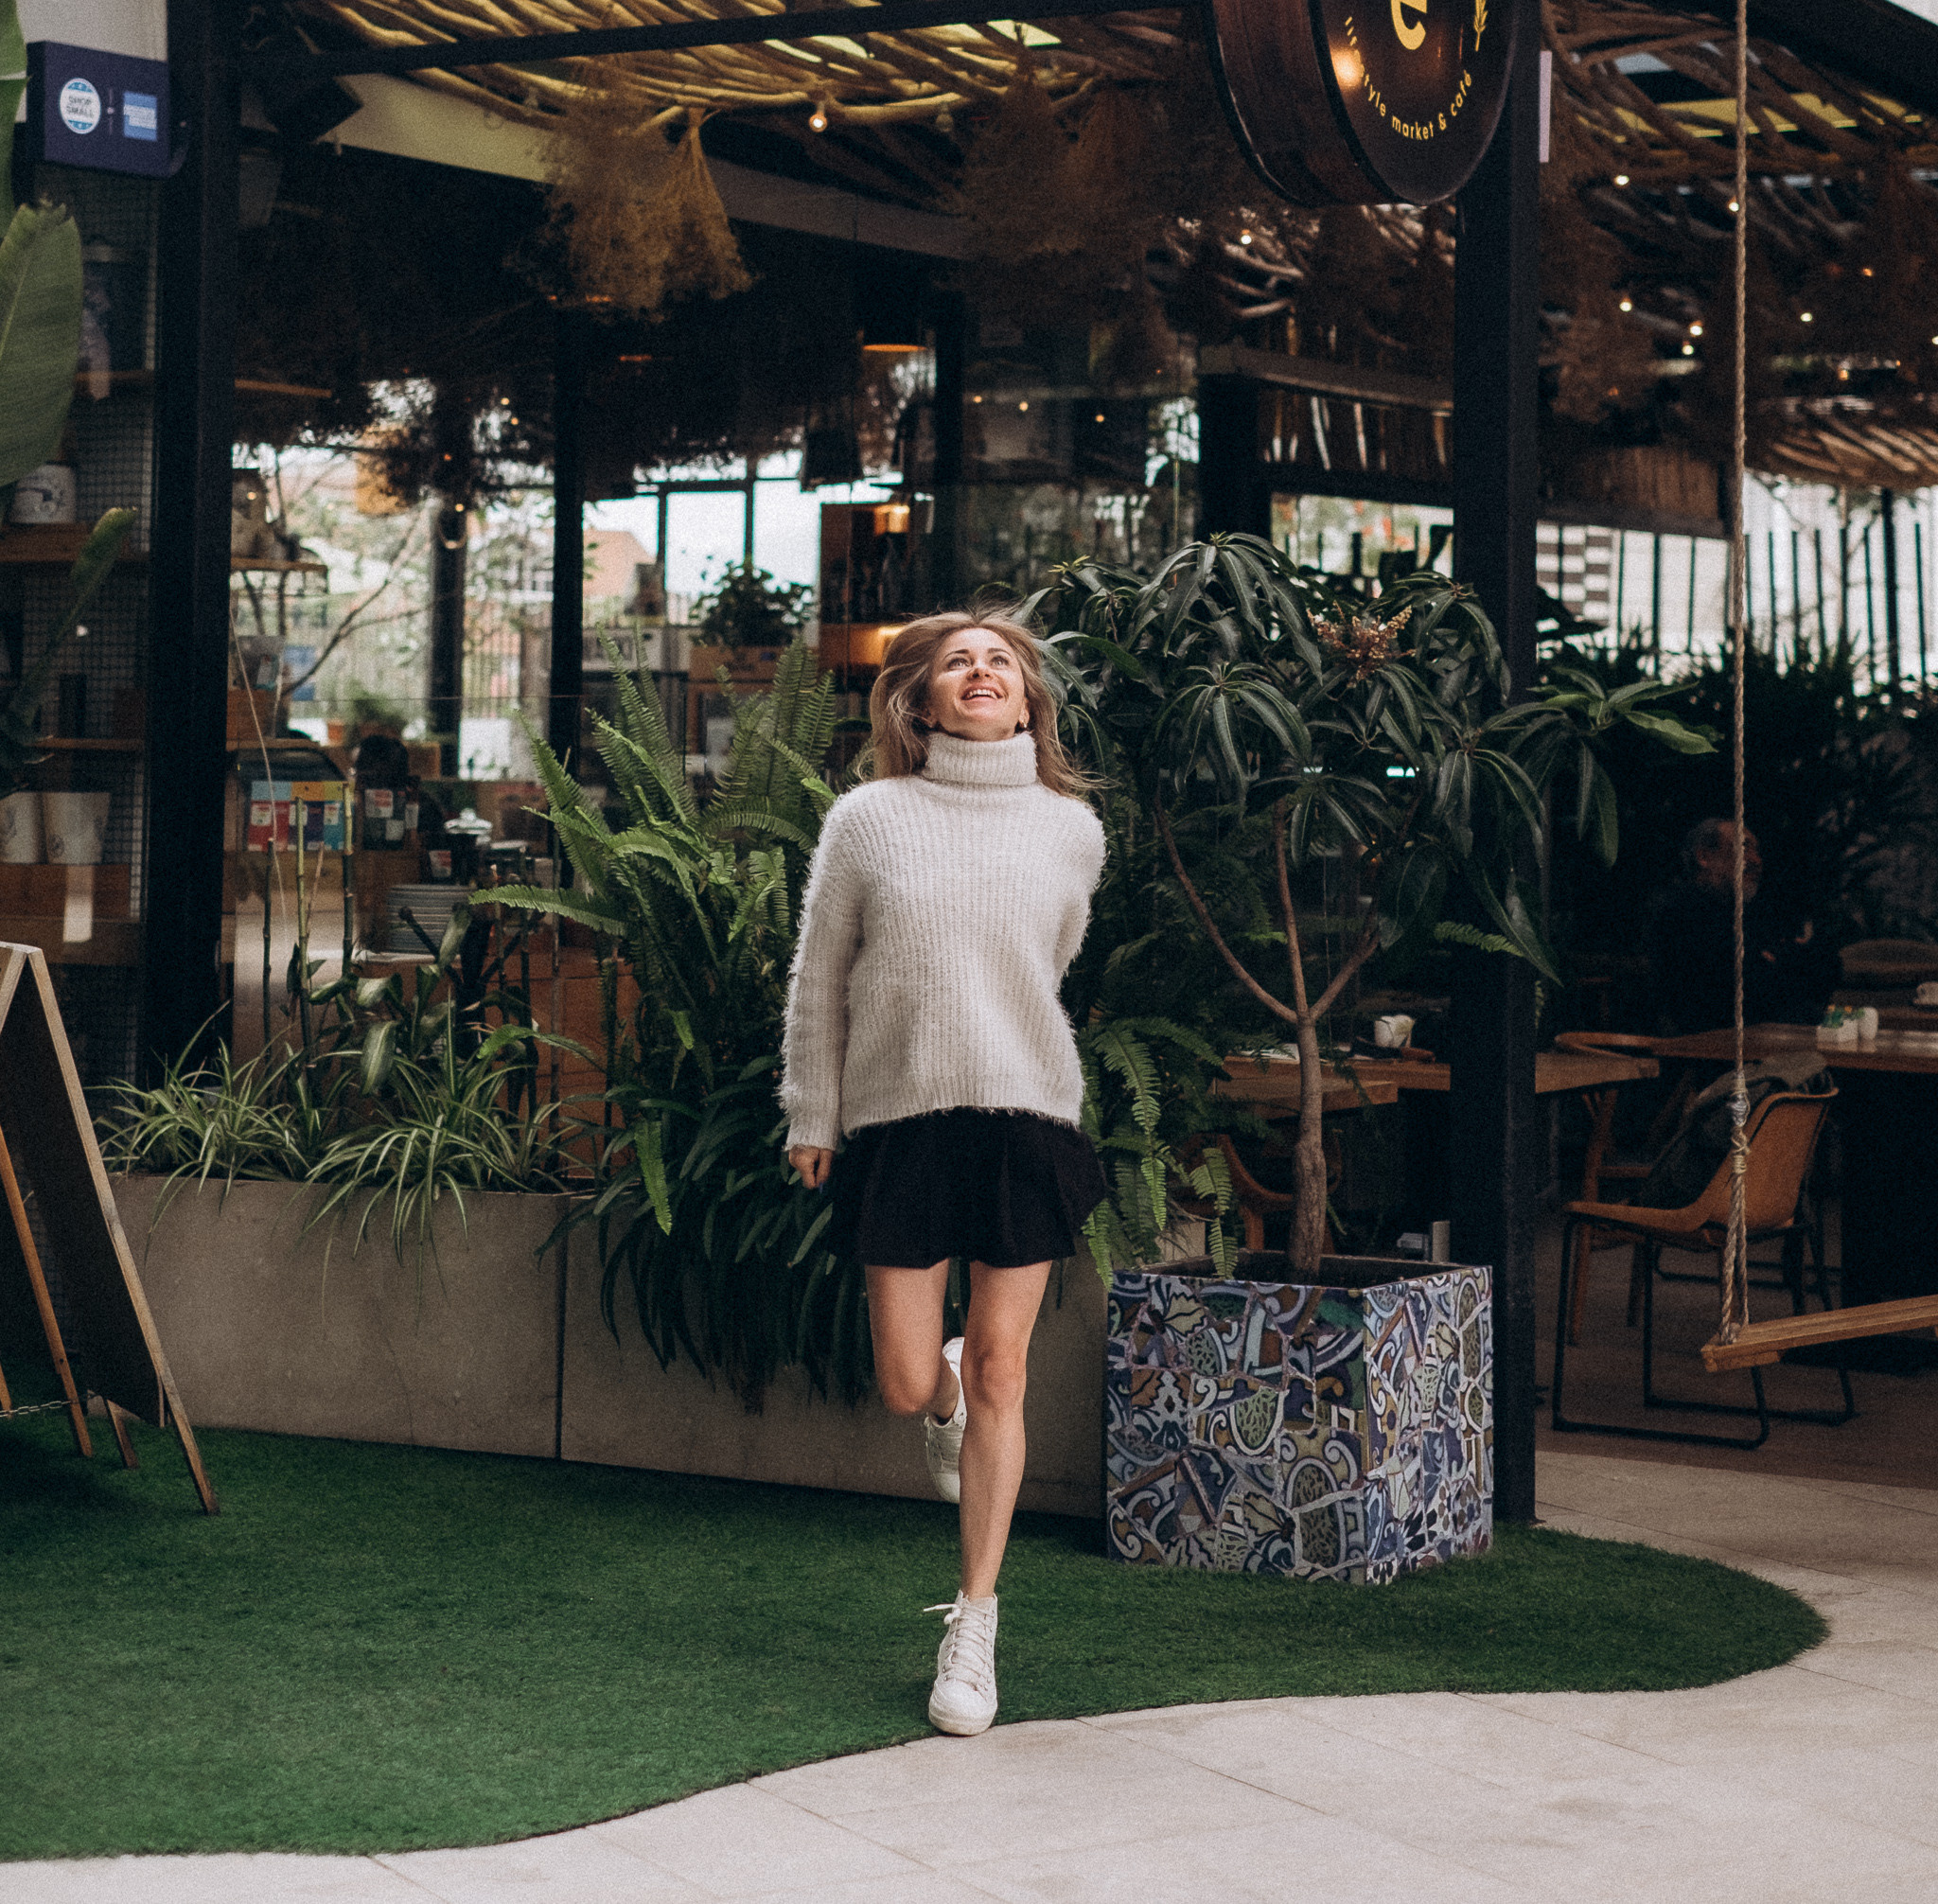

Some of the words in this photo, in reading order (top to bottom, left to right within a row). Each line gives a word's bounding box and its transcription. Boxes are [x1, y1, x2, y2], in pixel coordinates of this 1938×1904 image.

[65, 105, 94, 118] SMALL
[1392, 115, 1434, 141] market
[1438, 113, 1447, 131] &
